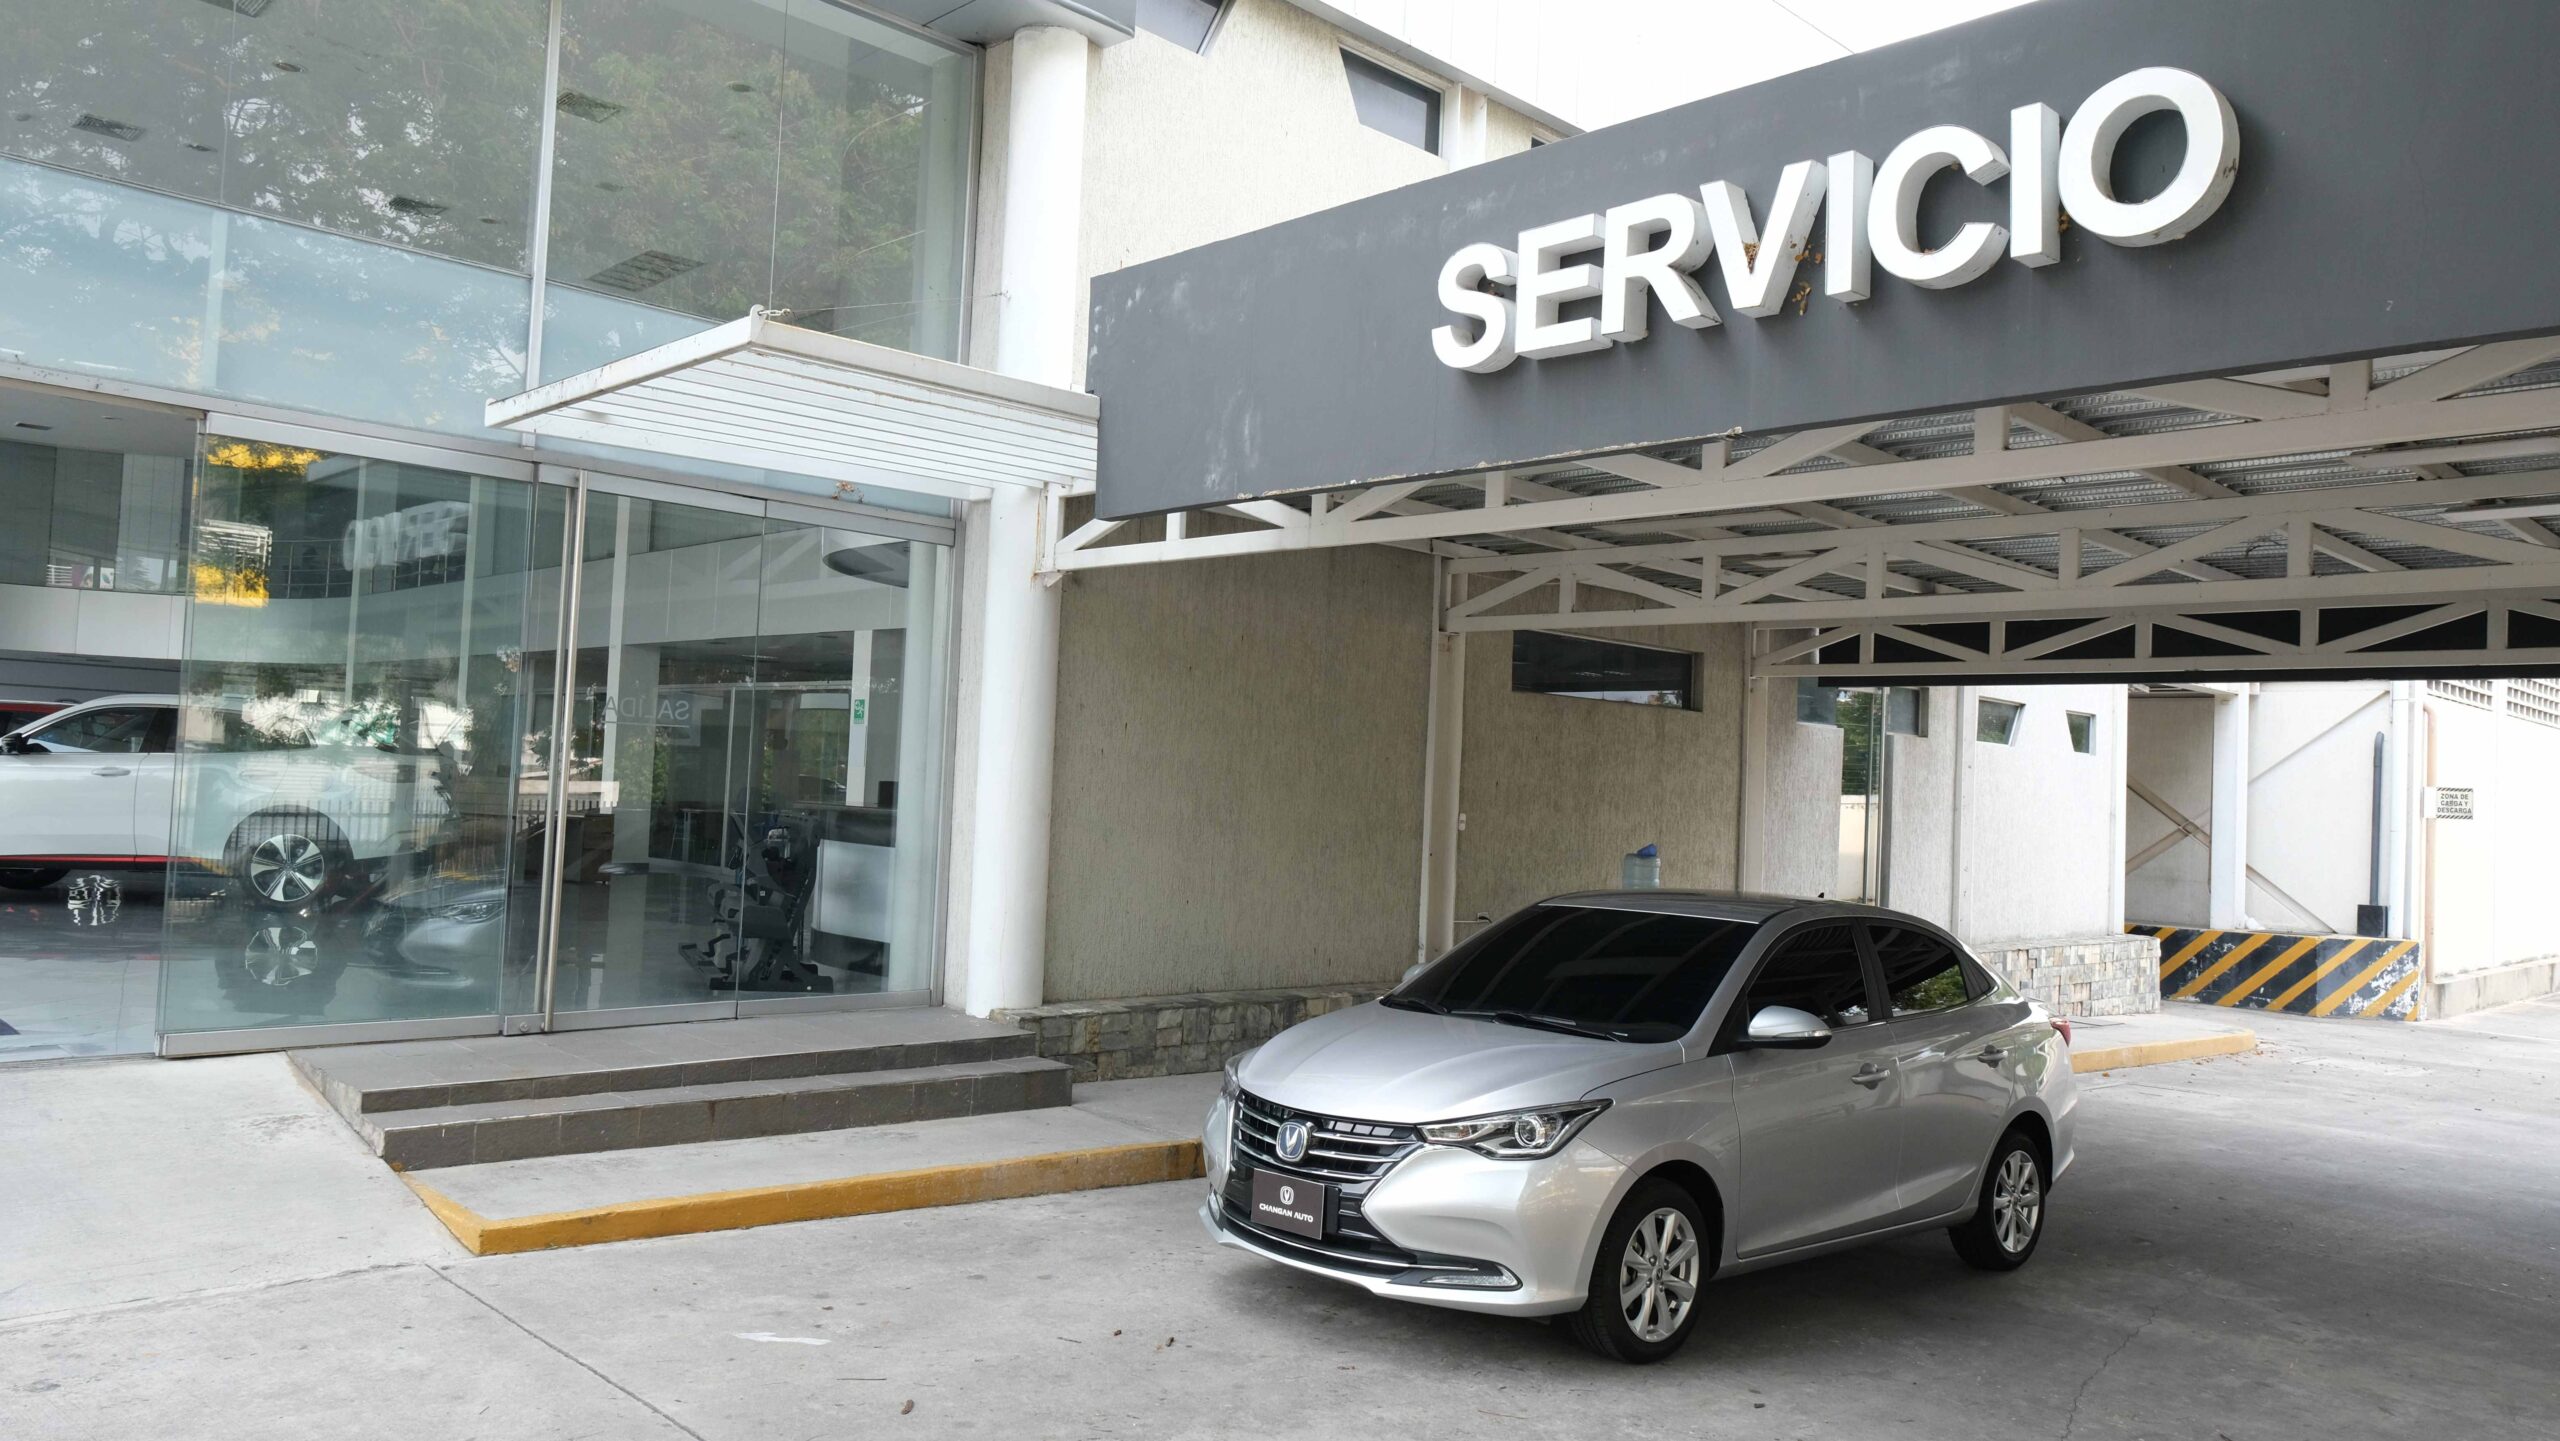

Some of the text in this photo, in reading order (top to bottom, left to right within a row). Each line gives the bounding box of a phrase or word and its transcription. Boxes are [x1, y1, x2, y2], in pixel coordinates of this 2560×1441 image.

[1430, 66, 2240, 374] SERVICIO
[1258, 1202, 1314, 1223] CHANGAN AUTO
